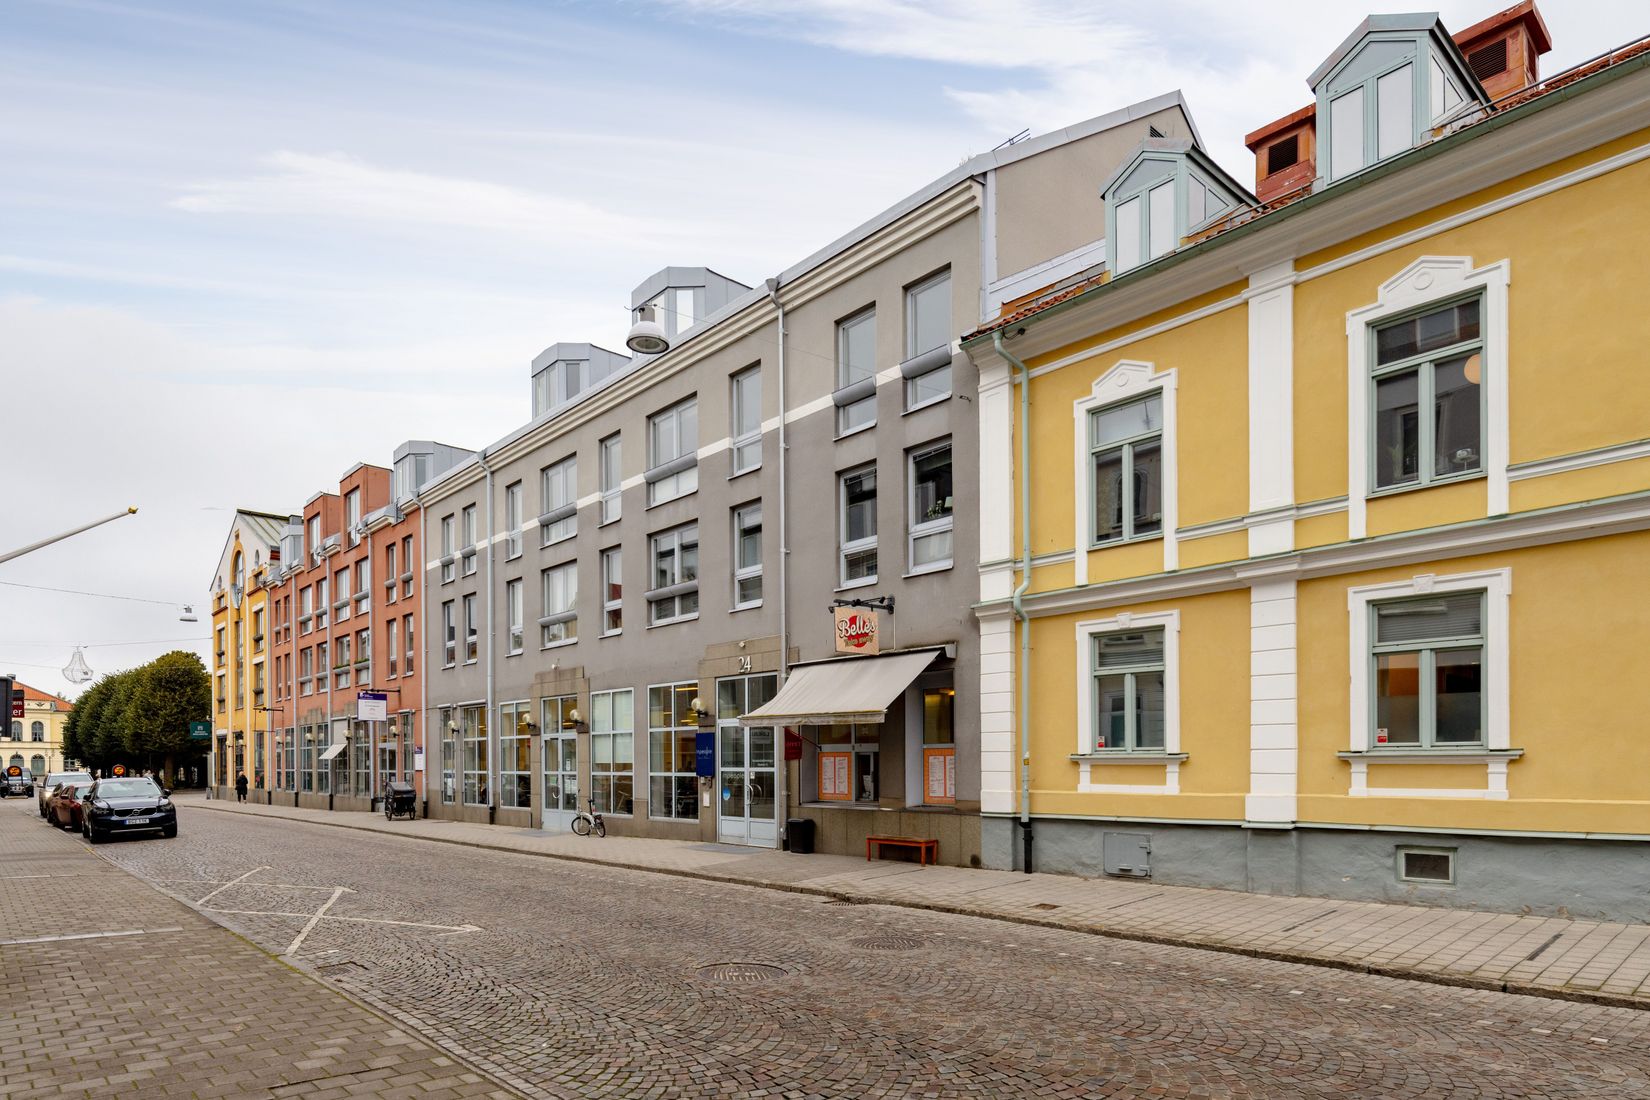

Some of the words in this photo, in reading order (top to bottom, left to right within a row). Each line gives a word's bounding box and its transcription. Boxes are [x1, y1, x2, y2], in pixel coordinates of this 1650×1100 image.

[837, 615, 876, 638] Belle's
[738, 655, 752, 673] 24
[12, 708, 23, 716] er
